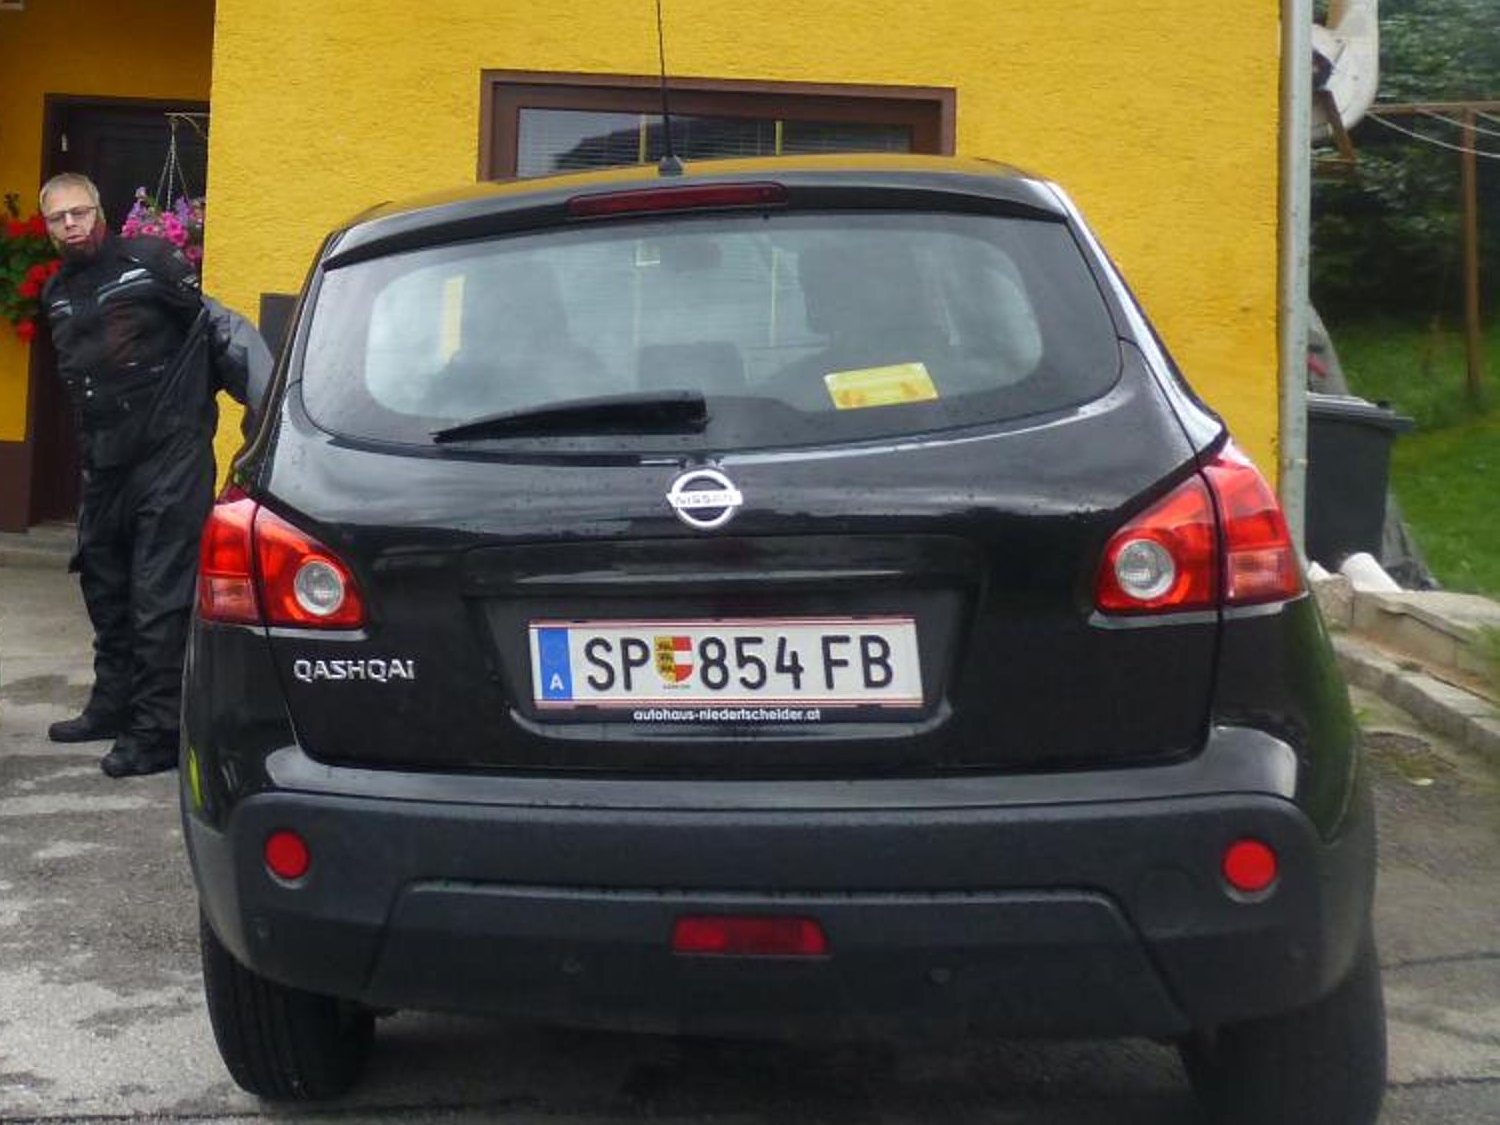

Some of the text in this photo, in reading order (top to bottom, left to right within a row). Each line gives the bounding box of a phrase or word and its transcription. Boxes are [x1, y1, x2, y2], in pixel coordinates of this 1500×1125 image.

[294, 659, 415, 683] QASHQAI
[584, 634, 893, 691] SP 854 FB
[550, 673, 564, 690] A
[633, 708, 821, 721] autohaus-niedertscheider.at
